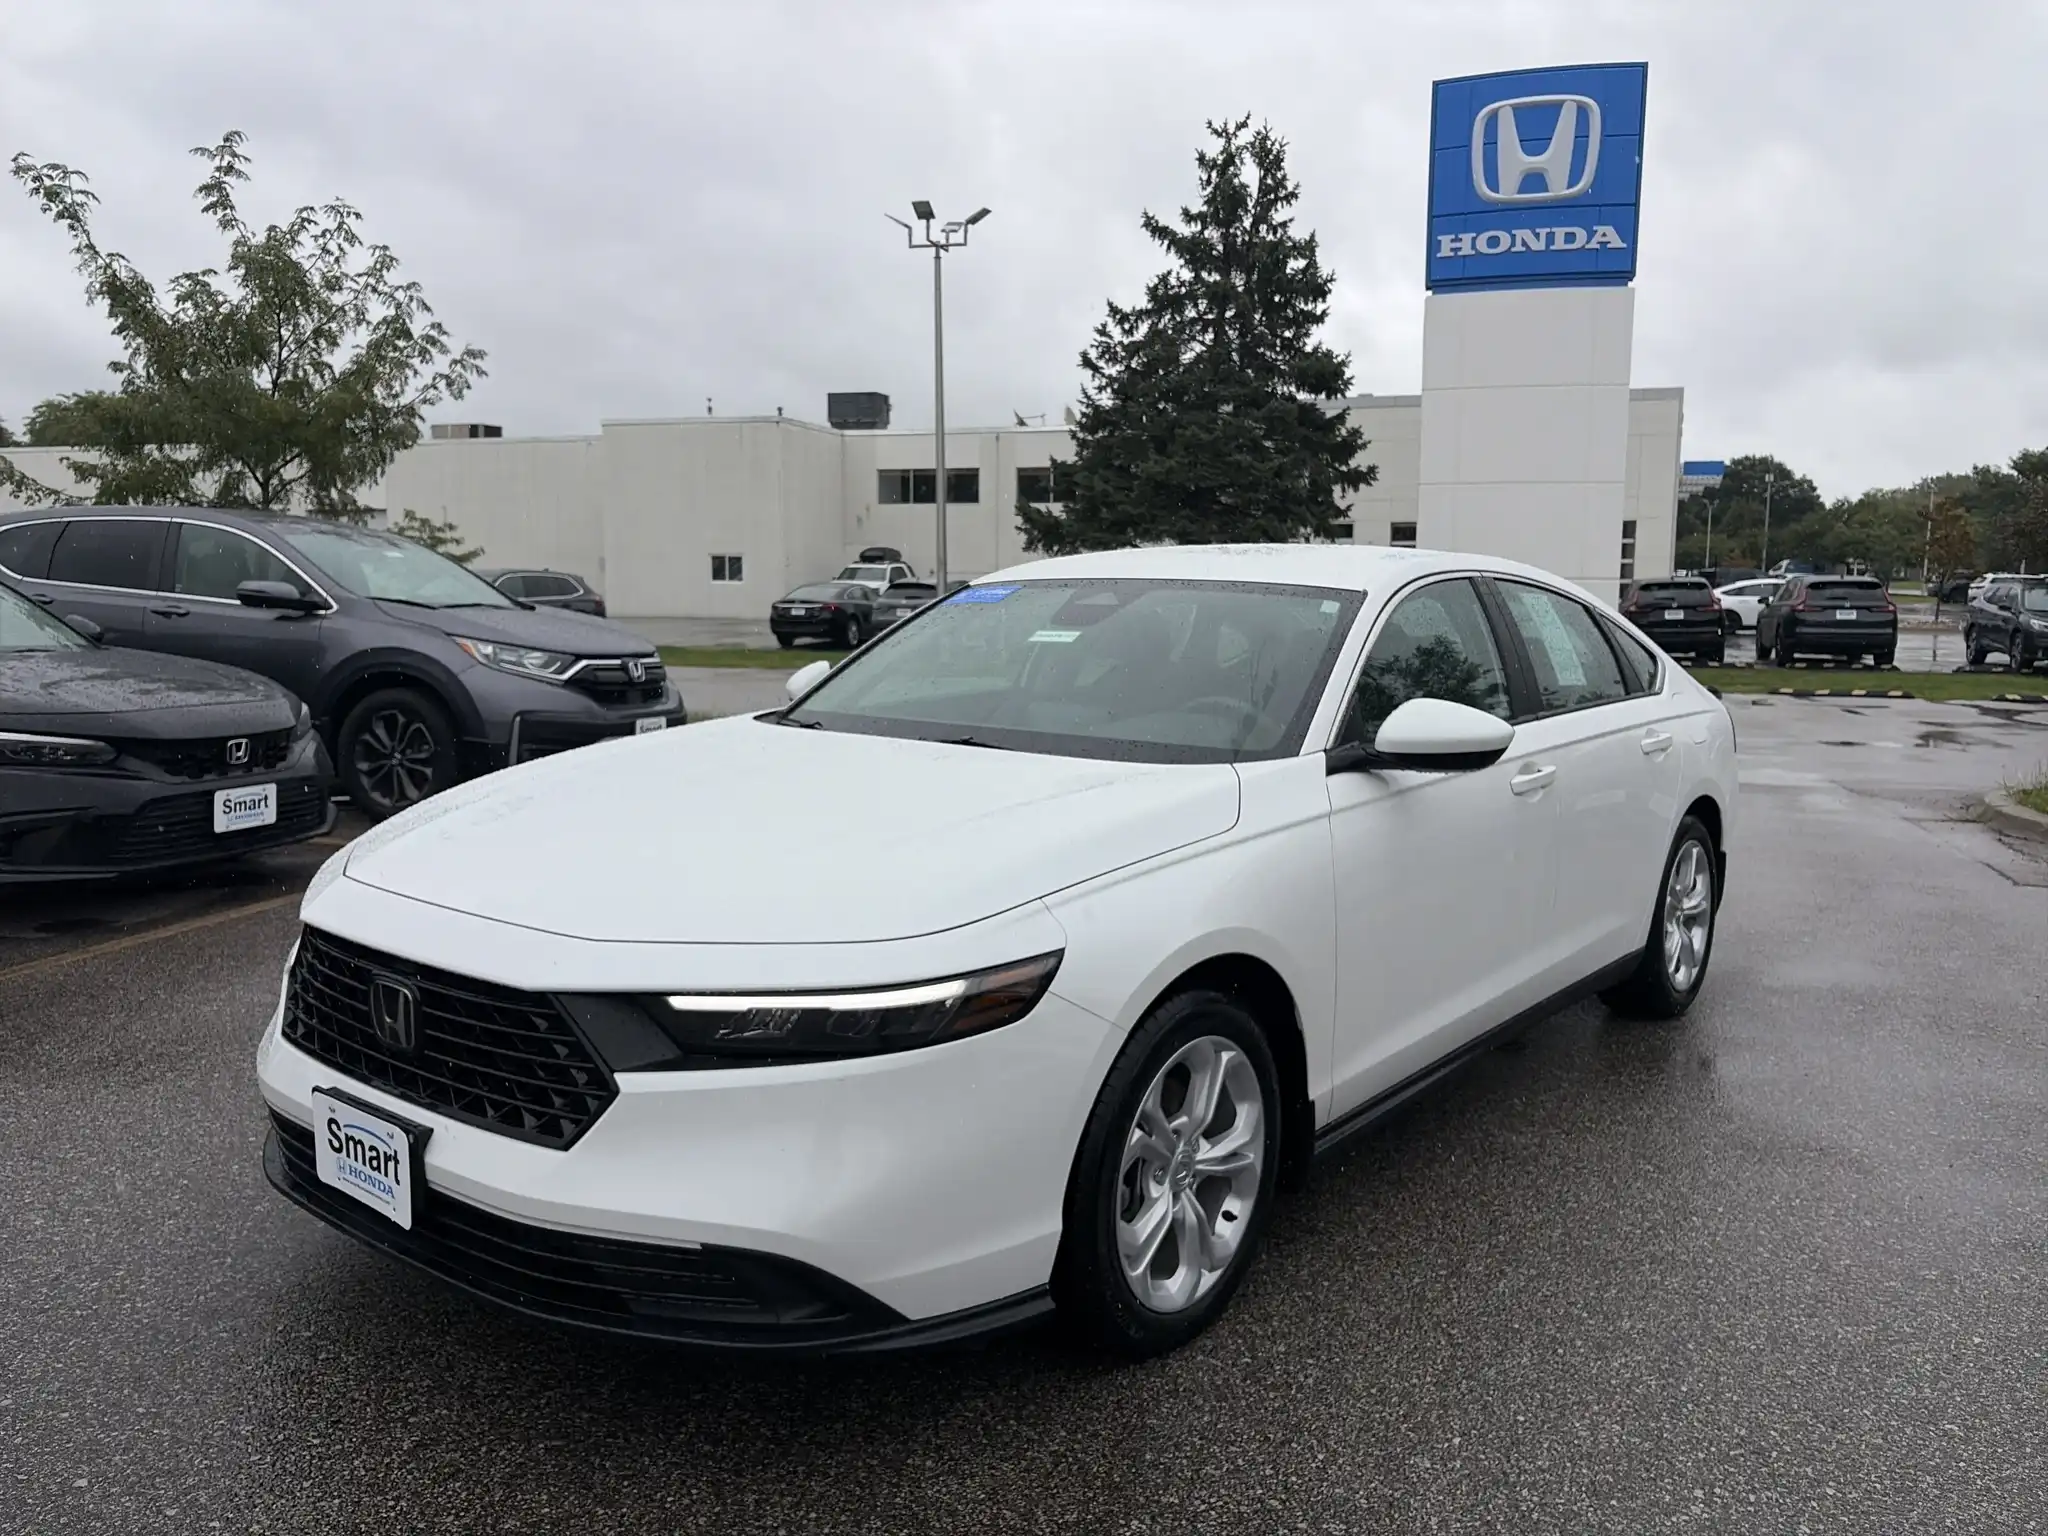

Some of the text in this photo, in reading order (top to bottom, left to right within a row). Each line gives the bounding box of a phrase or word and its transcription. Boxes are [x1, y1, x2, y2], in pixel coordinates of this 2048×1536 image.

[1436, 225, 1627, 258] HONDA
[222, 794, 269, 815] Smart
[327, 1117, 401, 1186] Smart
[348, 1164, 395, 1200] HONDA
